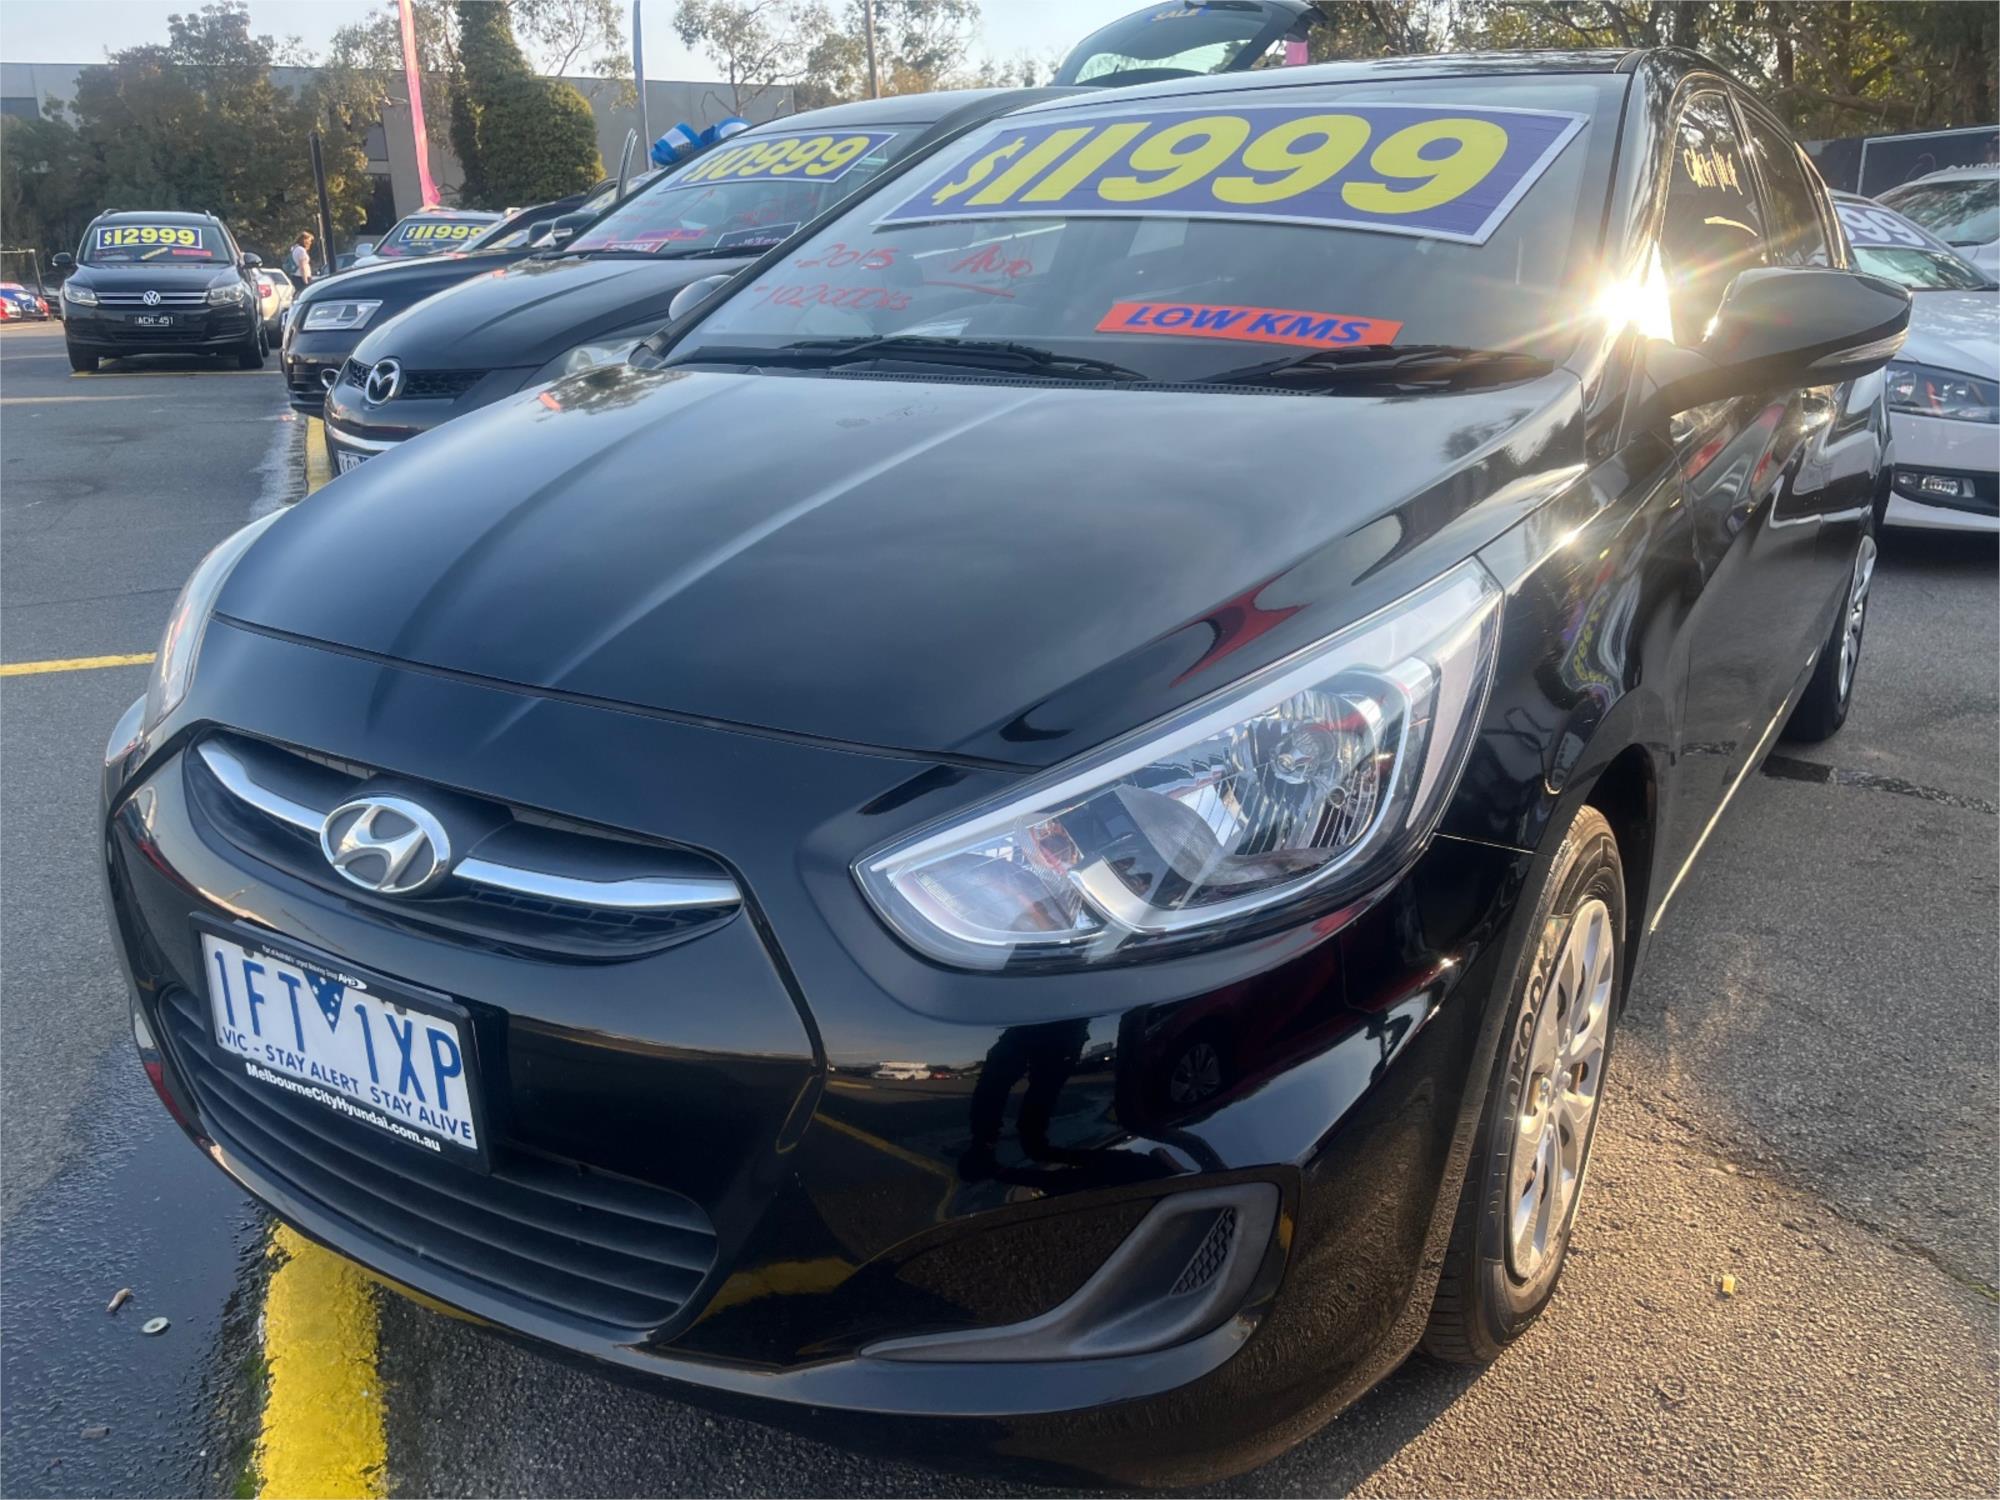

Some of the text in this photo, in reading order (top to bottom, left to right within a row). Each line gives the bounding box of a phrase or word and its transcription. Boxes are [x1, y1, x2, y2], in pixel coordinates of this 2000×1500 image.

[681, 136, 870, 182] $10999
[931, 114, 1508, 214] $11999
[104, 228, 195, 245] $12999
[1123, 306, 1370, 343] LOW KMS
[215, 949, 463, 1111] 1FT 1XP
[223, 1027, 248, 1051] VIC
[266, 1045, 307, 1072] STAY
[311, 1061, 359, 1095] ALERT
[370, 1086, 413, 1118] STAY
[419, 1106, 473, 1140] ALIVE
[245, 1062, 441, 1152] MelbourneCityHyundai.com.au
